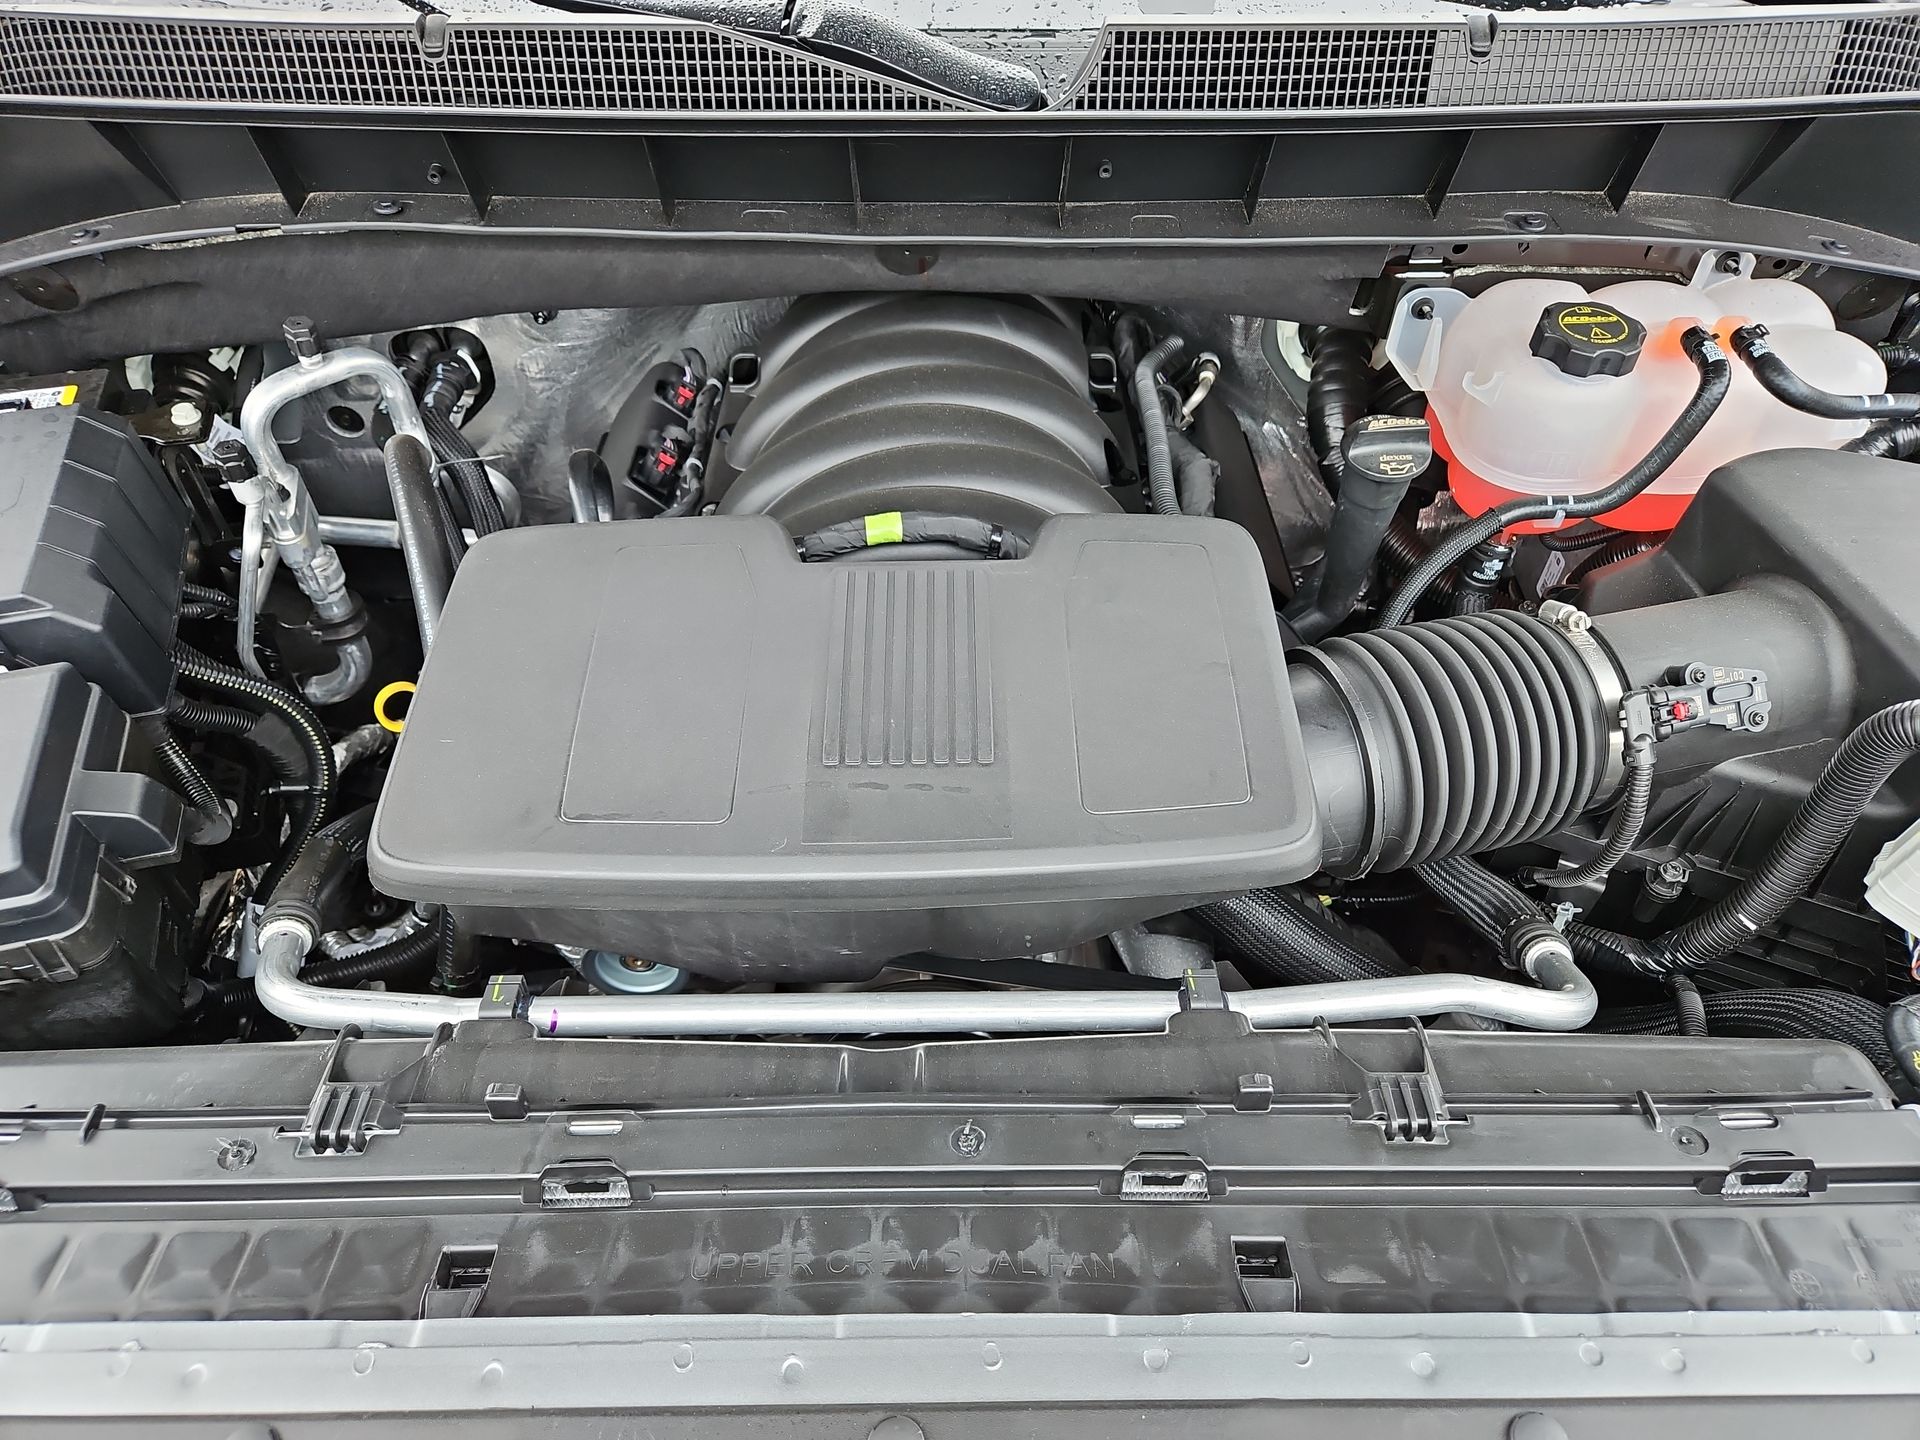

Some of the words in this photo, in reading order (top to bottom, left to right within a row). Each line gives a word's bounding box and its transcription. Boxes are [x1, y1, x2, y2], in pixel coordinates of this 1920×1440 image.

[1561, 315, 1618, 324] ACDelco
[1368, 417, 1426, 430] ACDelco
[1379, 454, 1413, 462] dexos
[690, 1250, 814, 1281] UPPER
[944, 1249, 1038, 1277] DUAL
[1049, 1251, 1116, 1279] FAN
